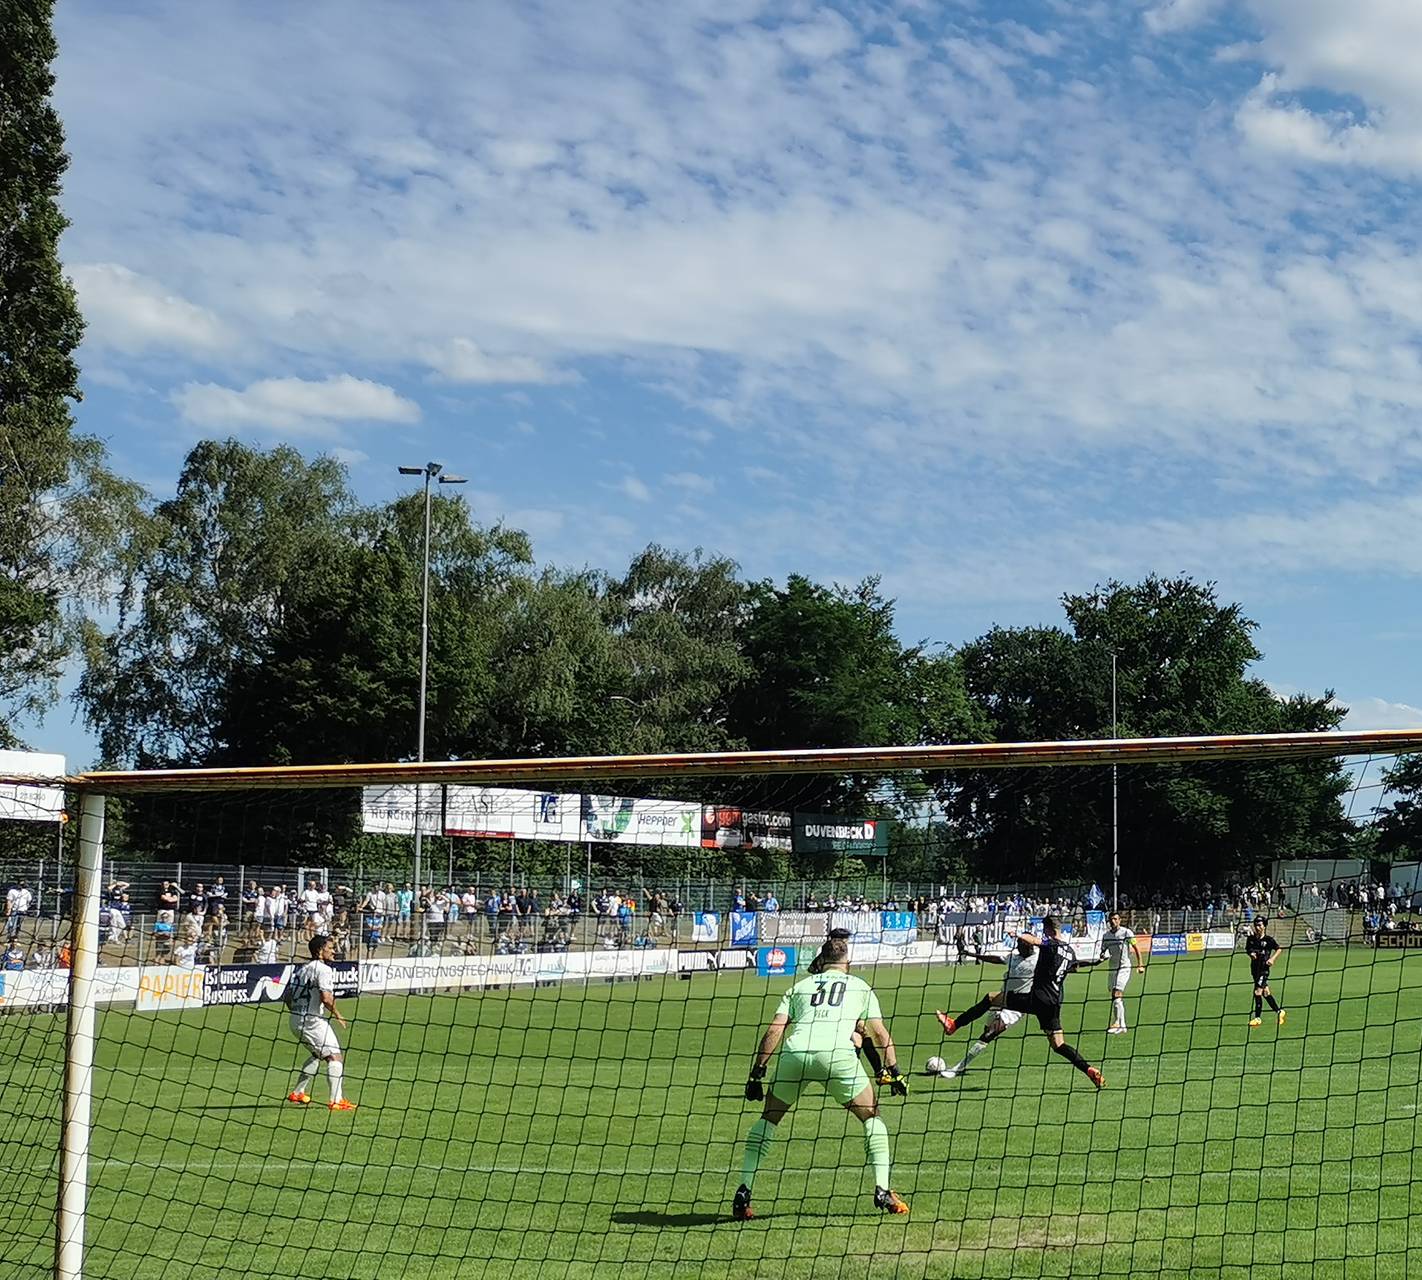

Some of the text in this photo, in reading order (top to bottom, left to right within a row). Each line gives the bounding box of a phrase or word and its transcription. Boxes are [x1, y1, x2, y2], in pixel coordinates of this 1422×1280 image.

[805, 824, 863, 839] DUVENBECK
[386, 962, 514, 980] SANIERUNGSTECHNIK
[139, 973, 203, 1003] PAPIER
[204, 986, 250, 1004] Business.
[810, 981, 846, 1007] 30
